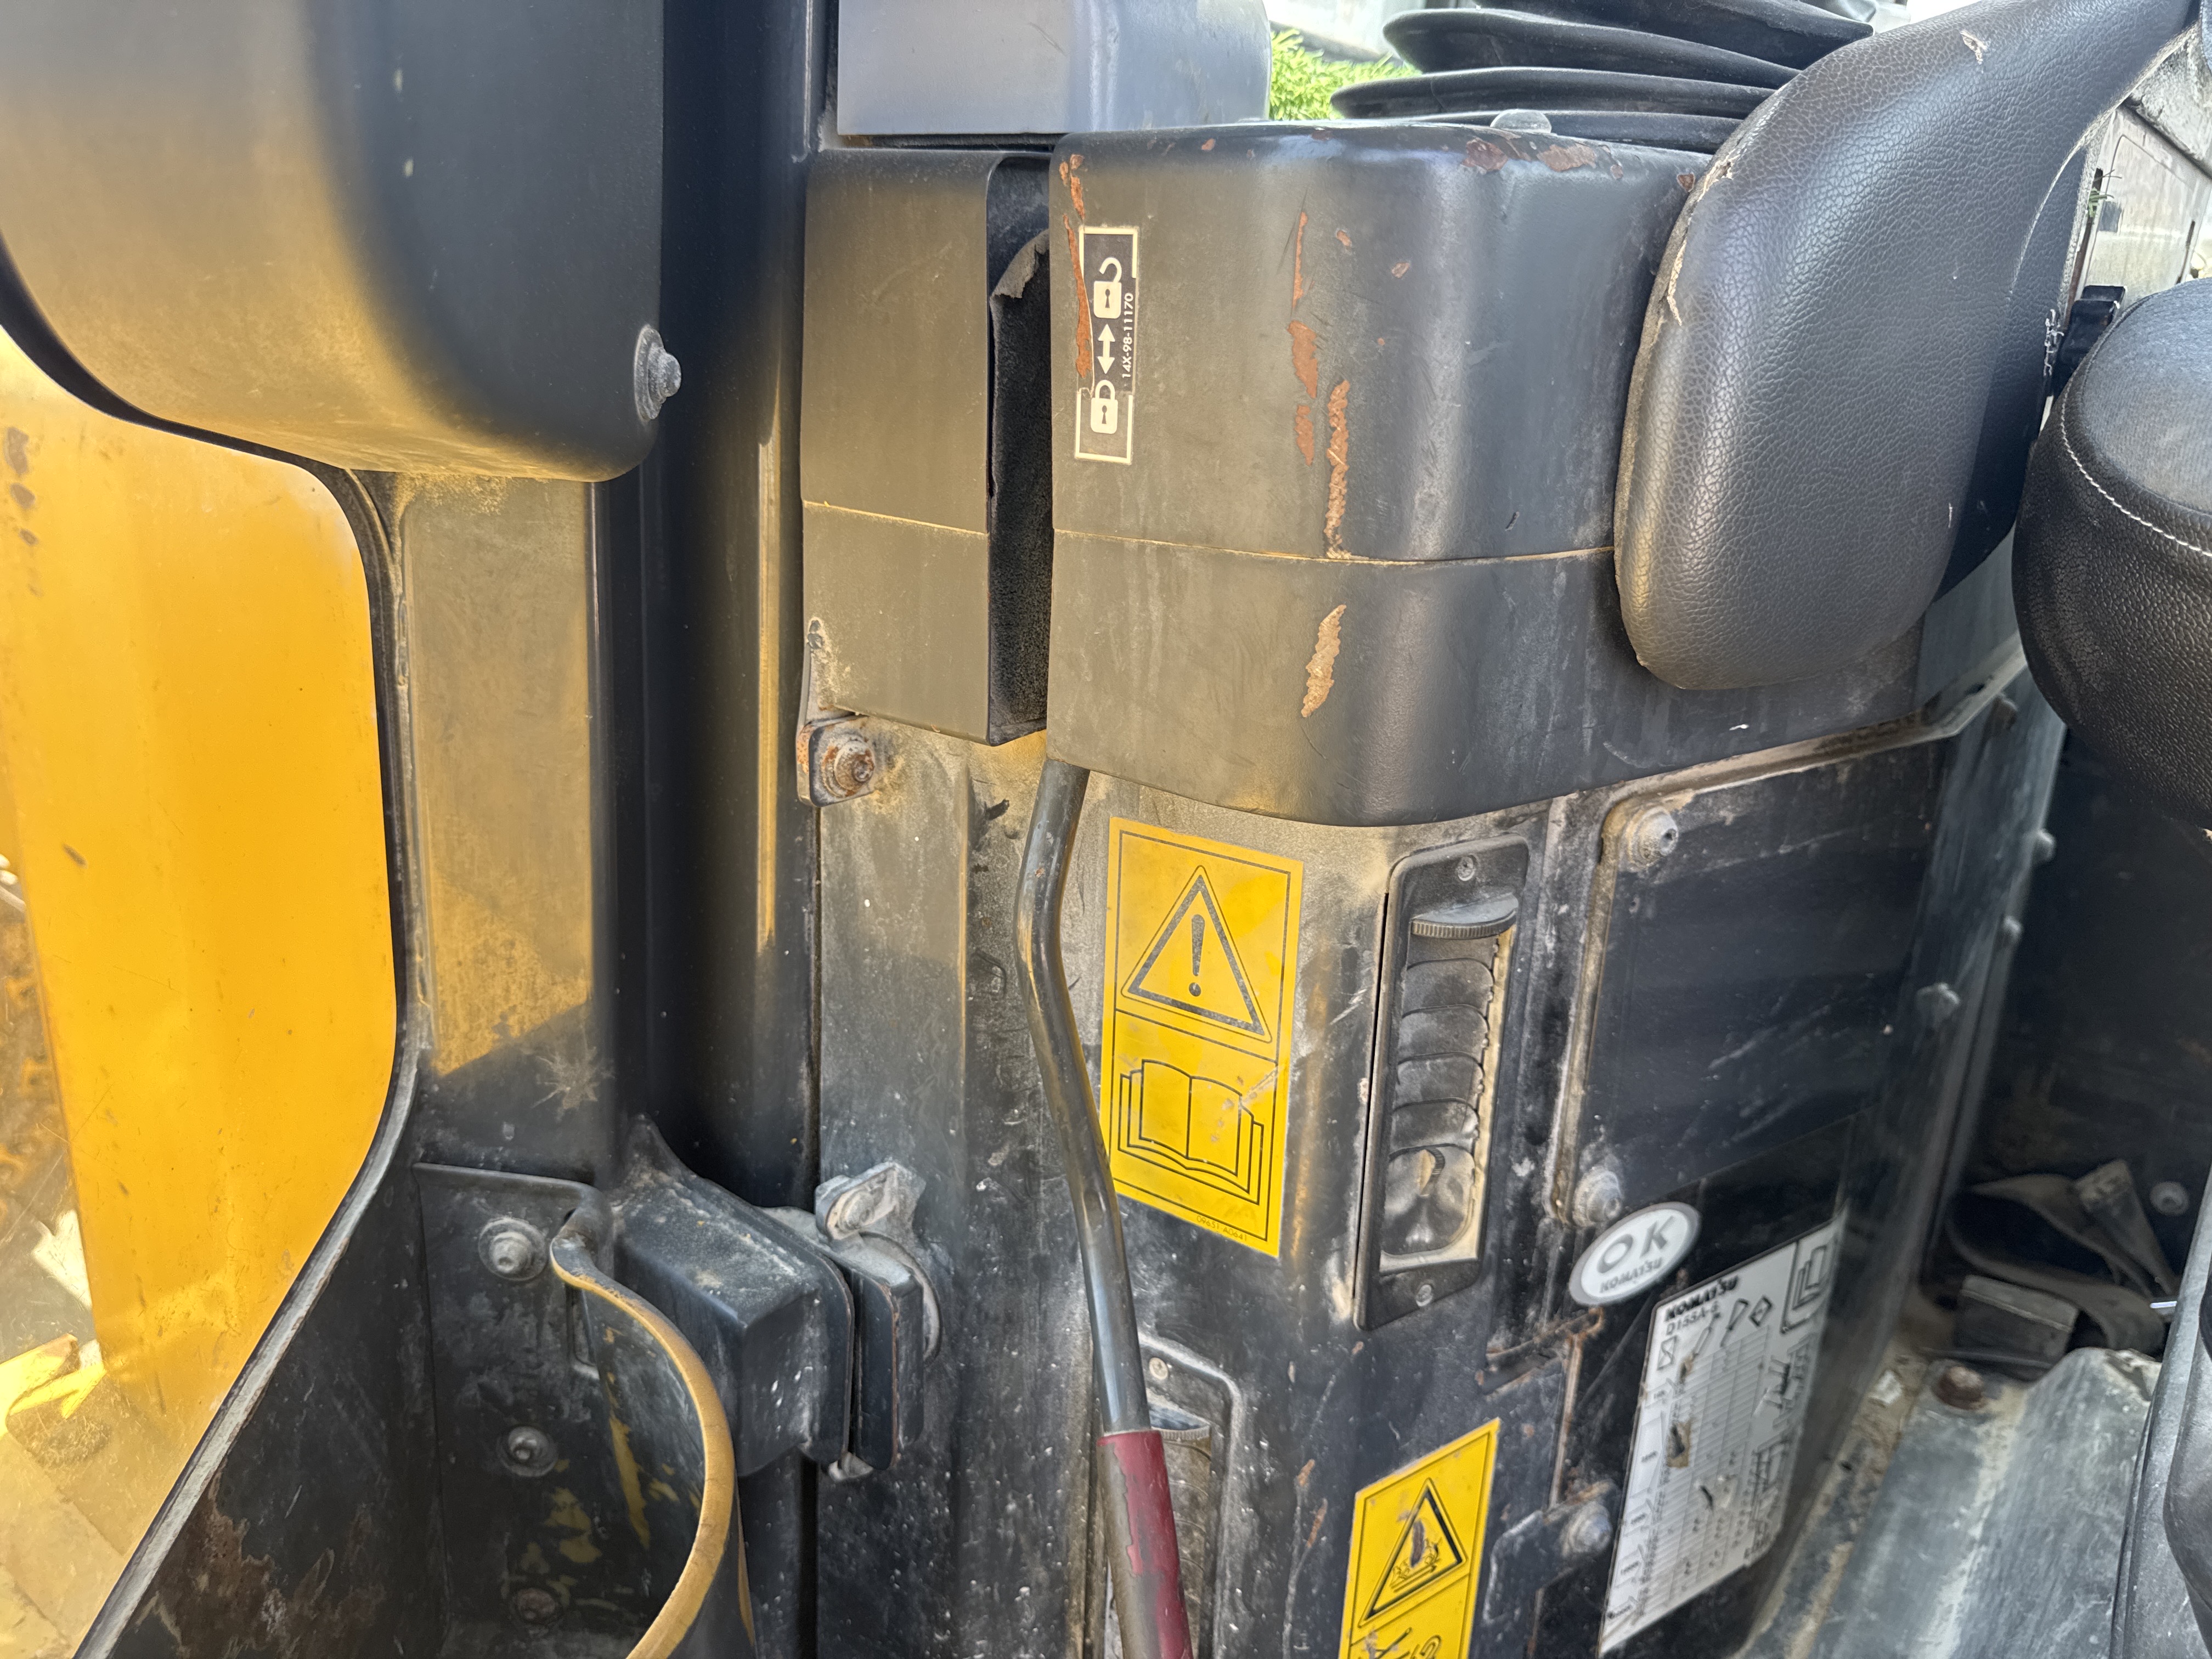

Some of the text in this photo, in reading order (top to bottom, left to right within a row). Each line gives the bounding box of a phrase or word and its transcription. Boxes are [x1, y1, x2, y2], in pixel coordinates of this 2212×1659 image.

[1122, 292, 1134, 379] 14X-98-11170
[1596, 1215, 1674, 1274] OK
[1599, 1257, 1662, 1294] KOMATSU
[1664, 1275, 1740, 1322] KOMATSU
